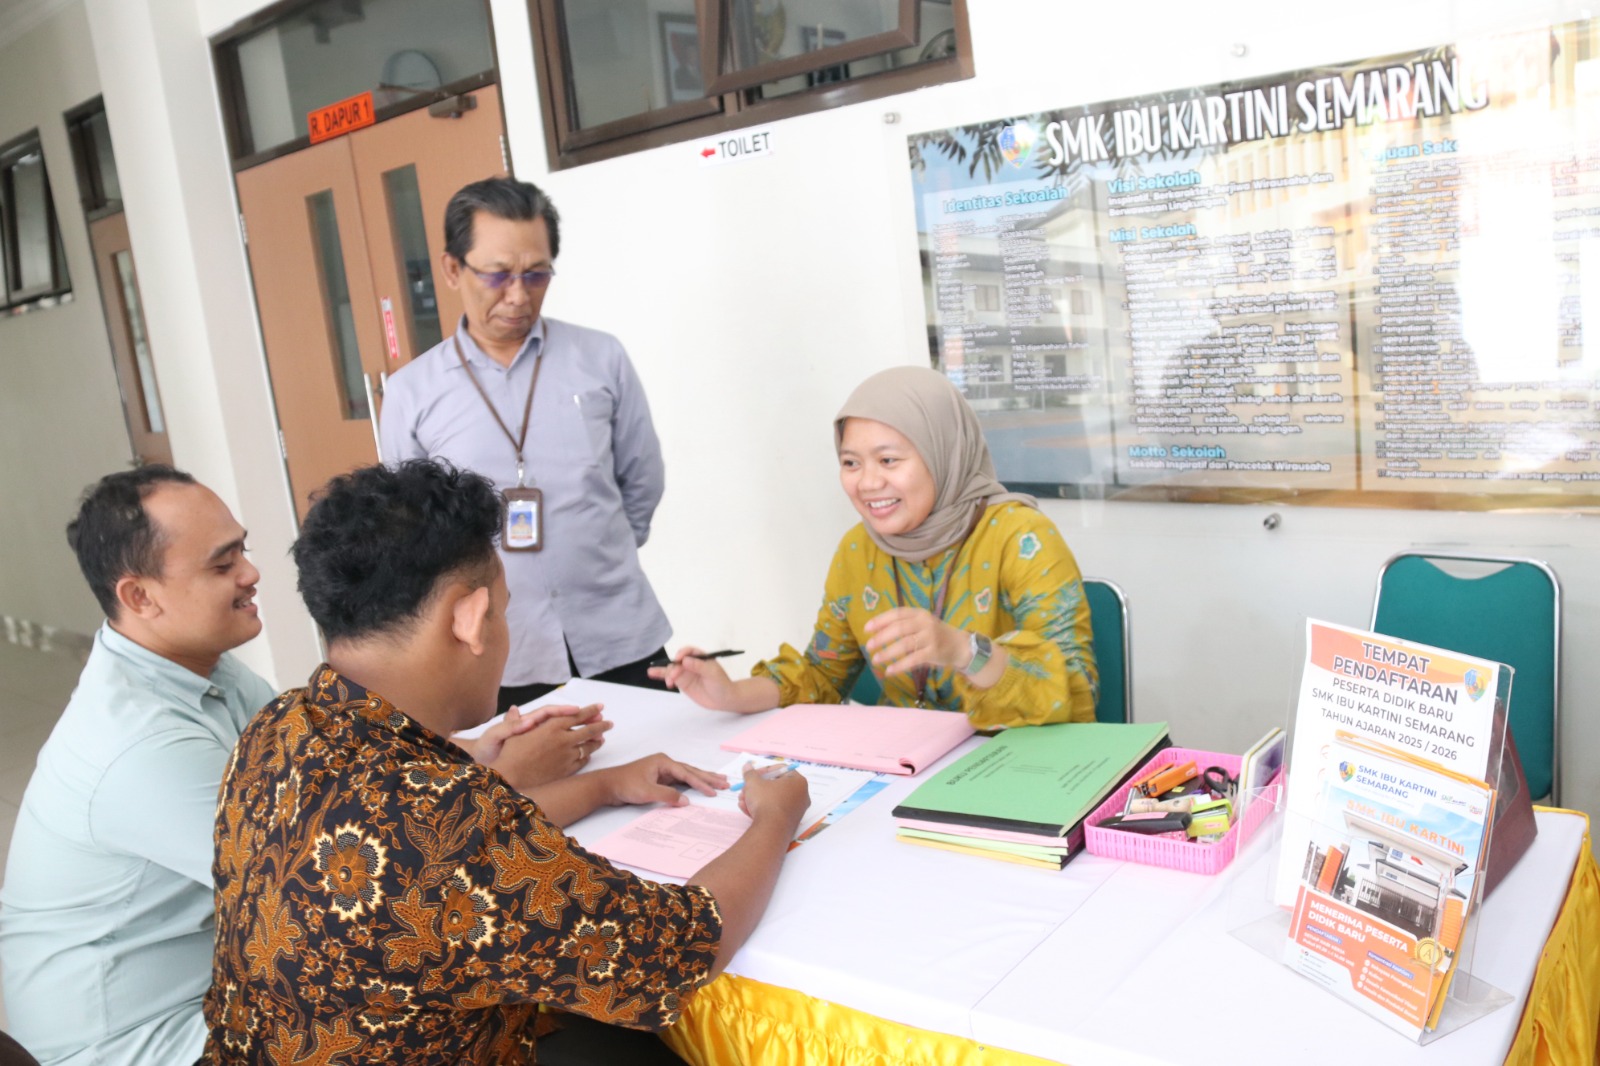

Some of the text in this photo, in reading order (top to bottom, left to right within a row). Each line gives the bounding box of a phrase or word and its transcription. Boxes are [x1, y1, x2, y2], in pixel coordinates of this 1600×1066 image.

[310, 99, 370, 136] R. DAPUR 1
[1045, 57, 1489, 167] SMK IBU KARTINI SEMARANG
[718, 131, 771, 159] TOILET
[1107, 169, 1201, 194] Visi Sekolah
[1214, 182, 1250, 196] Berjiwa
[1253, 175, 1309, 190] Wirausaha
[1311, 173, 1334, 184] dan
[1418, 180, 1437, 190] dan
[943, 194, 1002, 214] Identitas
[1109, 203, 1167, 217] Berwawasan
[1109, 223, 1197, 243] Misi Sekolah
[1254, 229, 1292, 241] sekolah
[1271, 272, 1290, 282] dan
[1228, 294, 1267, 305] beriman
[1268, 293, 1287, 302] dan
[1238, 302, 1308, 314] berbudi pekerti
[1222, 321, 1339, 335] pendidikan kecakapan
[1240, 334, 1272, 344] alumni
[1276, 333, 1300, 345] yang
[1244, 345, 1263, 354] dan
[1209, 355, 1235, 364] untuk
[1238, 354, 1268, 363] berani
[1270, 353, 1318, 363] berinovasi
[1321, 352, 1340, 362] dan
[1189, 366, 1224, 377] peluang
[1181, 373, 1342, 387] siswa dengan kompetensi kejuruan
[1166, 384, 1236, 397] predikat unggul.
[1182, 393, 1343, 407] pembiasaan hidup sehat dan bersih
[1447, 399, 1590, 412] aktif dalam setiap kegiatan
[1145, 404, 1192, 417] lingkungan
[1203, 414, 1239, 424] sekolah
[1253, 413, 1290, 426] sebagai
[1304, 413, 1344, 424] wahana
[1137, 424, 1303, 436] pembelajaran yang ramah lingkungan.
[1129, 444, 1226, 458] Motto Sekolah
[1129, 458, 1331, 473] Sekolah Inspiratif dan Pencetak Wirausaha
[1362, 642, 1430, 673] TEMPAT
[1333, 655, 1458, 705] PENDAFTARAN
[1332, 677, 1454, 722] PESERTA DIDIK BARU
[1311, 687, 1475, 748] SMK IBU KARTINI SEMARANG
[1321, 707, 1458, 761] TAHUN AJARAN 2025 / 2026
[1356, 774, 1409, 799] SEMARANG
[1358, 764, 1379, 778] SMK
[1380, 770, 1397, 785] IBU
[1399, 775, 1437, 799] KARTINI
[1346, 799, 1465, 857] SMK IBU KARTINI
[1308, 910, 1367, 944] DIDIK BARU
[1310, 899, 1409, 953] MENERIMA PESERTA
